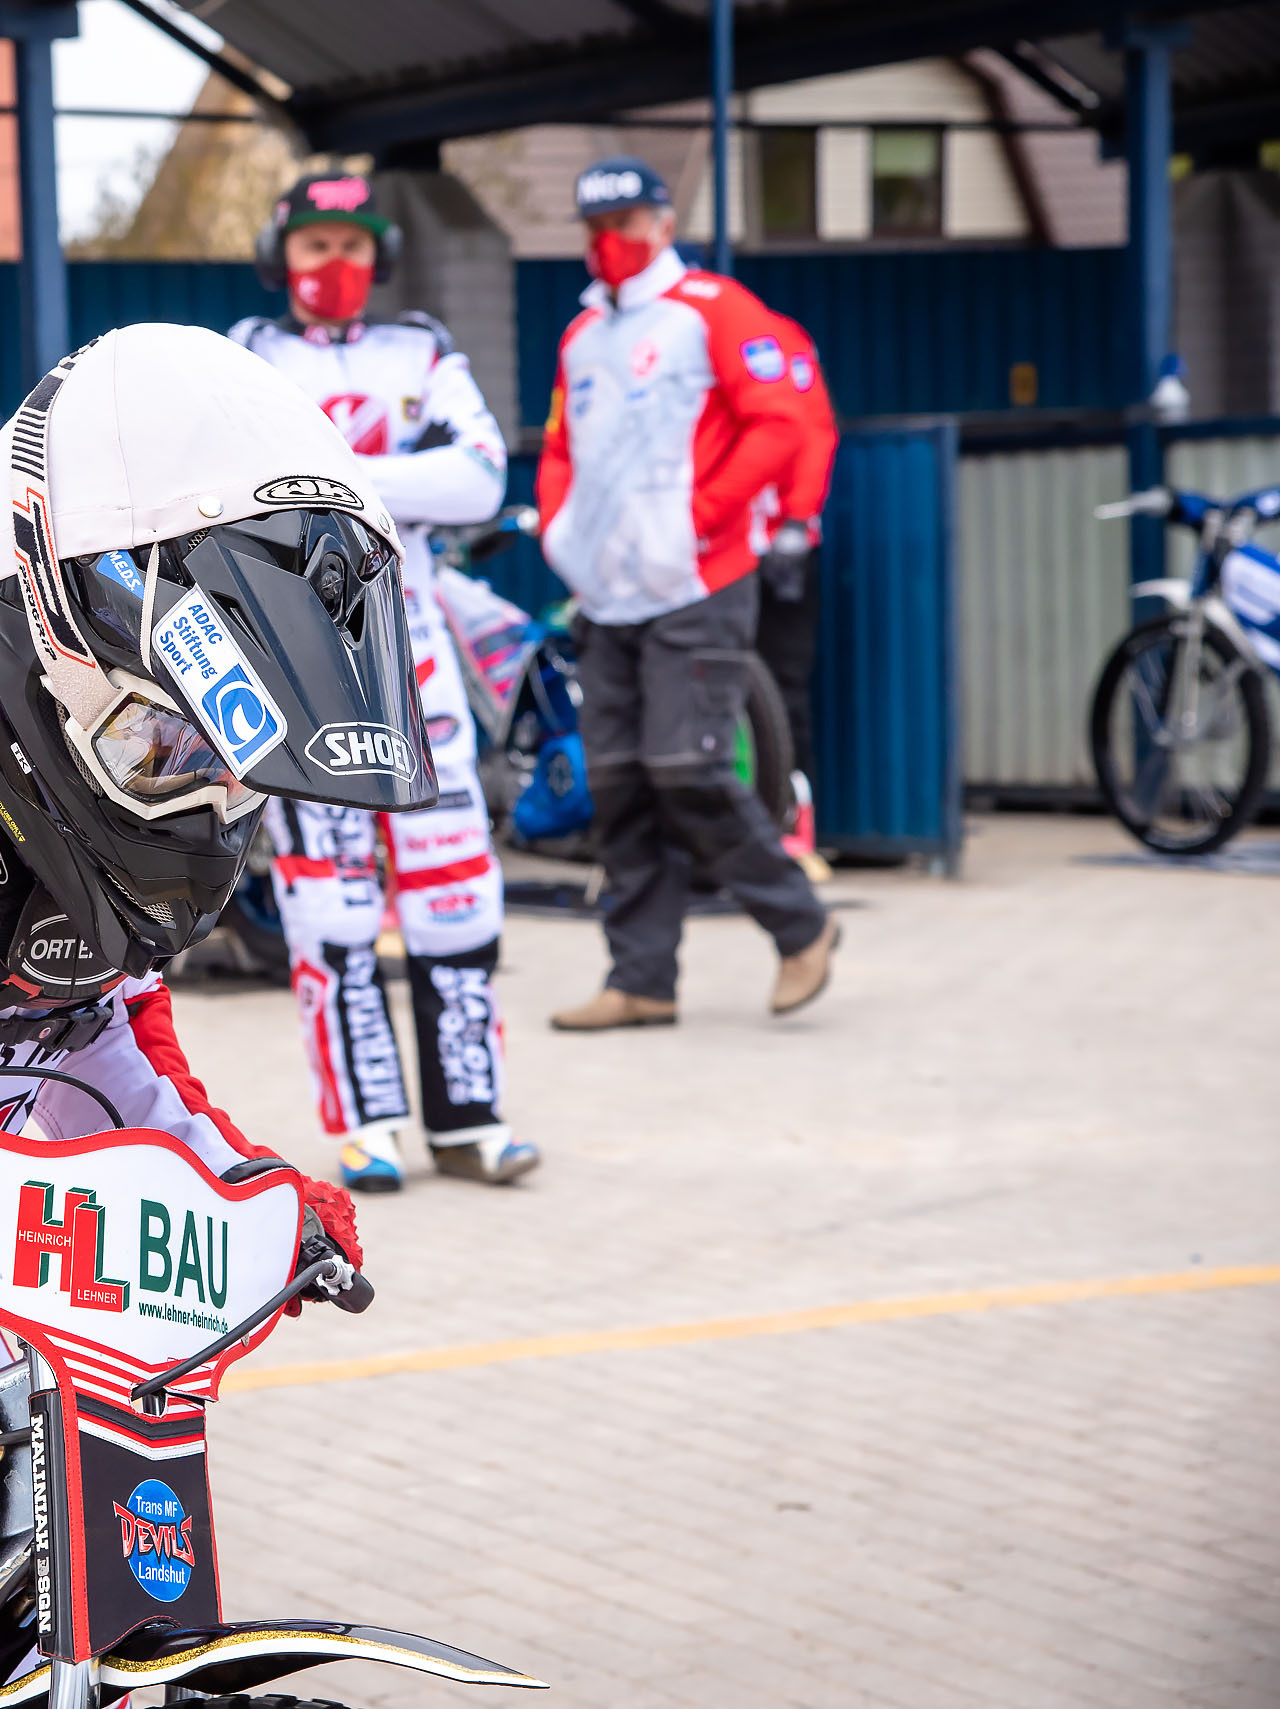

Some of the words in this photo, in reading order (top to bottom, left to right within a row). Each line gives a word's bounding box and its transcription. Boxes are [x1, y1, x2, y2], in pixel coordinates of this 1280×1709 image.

[188, 604, 223, 645] ADAC
[160, 631, 193, 675] Sport
[173, 616, 218, 680] Stiftung
[328, 731, 412, 774] SHOEI
[30, 938, 93, 960] ORTE
[18, 1229, 72, 1247] HEINRICH
[138, 1198, 229, 1310] BAU
[77, 1288, 118, 1305] LEHNER
[138, 1301, 229, 1335] www.lehner-heinrich.de
[135, 1495, 163, 1516] Trans
[164, 1500, 178, 1518] MF
[112, 1500, 196, 1568] DEVILS
[138, 1561, 186, 1585] Landshut
